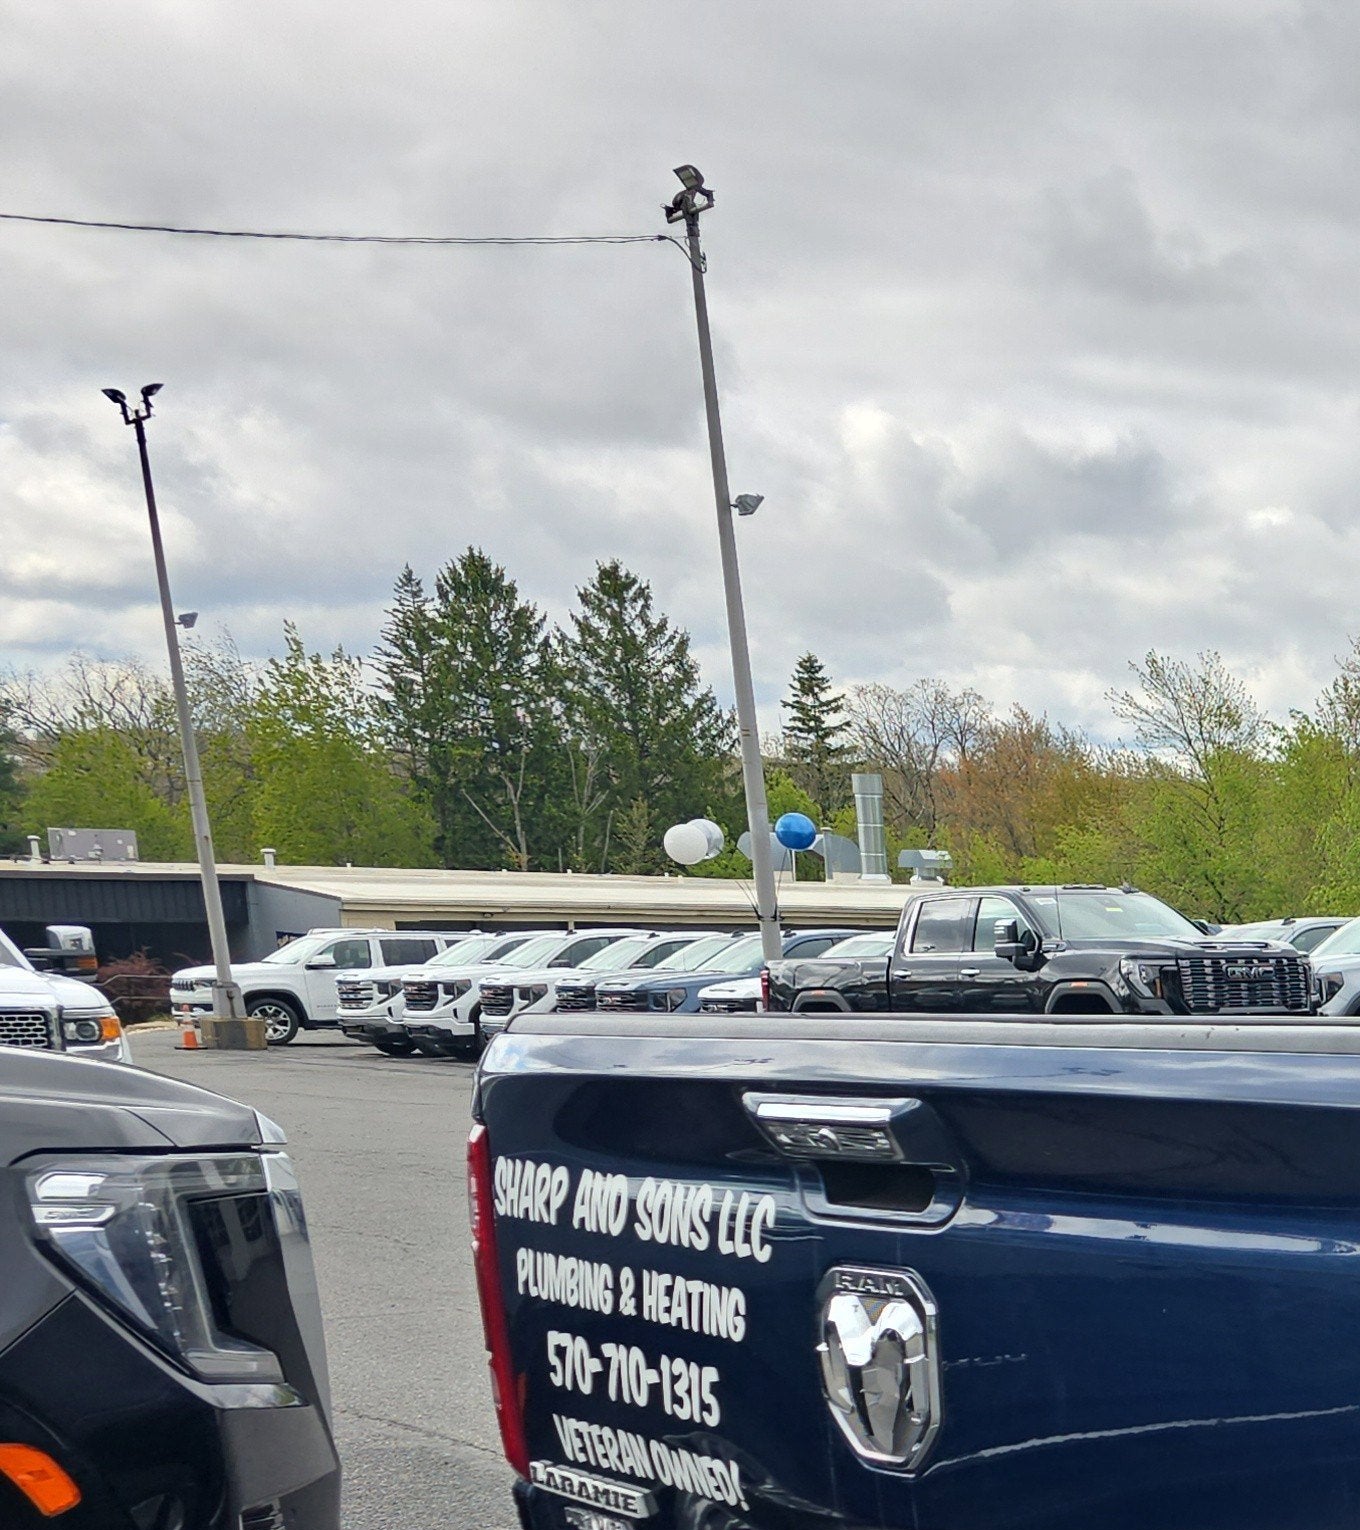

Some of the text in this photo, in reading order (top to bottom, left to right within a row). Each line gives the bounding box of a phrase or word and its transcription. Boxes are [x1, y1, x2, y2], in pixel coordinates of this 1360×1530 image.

[494, 1156, 776, 1263] SHARP AND SONS LLC
[516, 1247, 747, 1343] PLUMBING & HEATING
[835, 1271, 905, 1297] RAM
[547, 1330, 721, 1428] 570-710-1315
[530, 1463, 641, 1515] LARAMIE
[552, 1413, 750, 1511] VETERAN OWNED!
